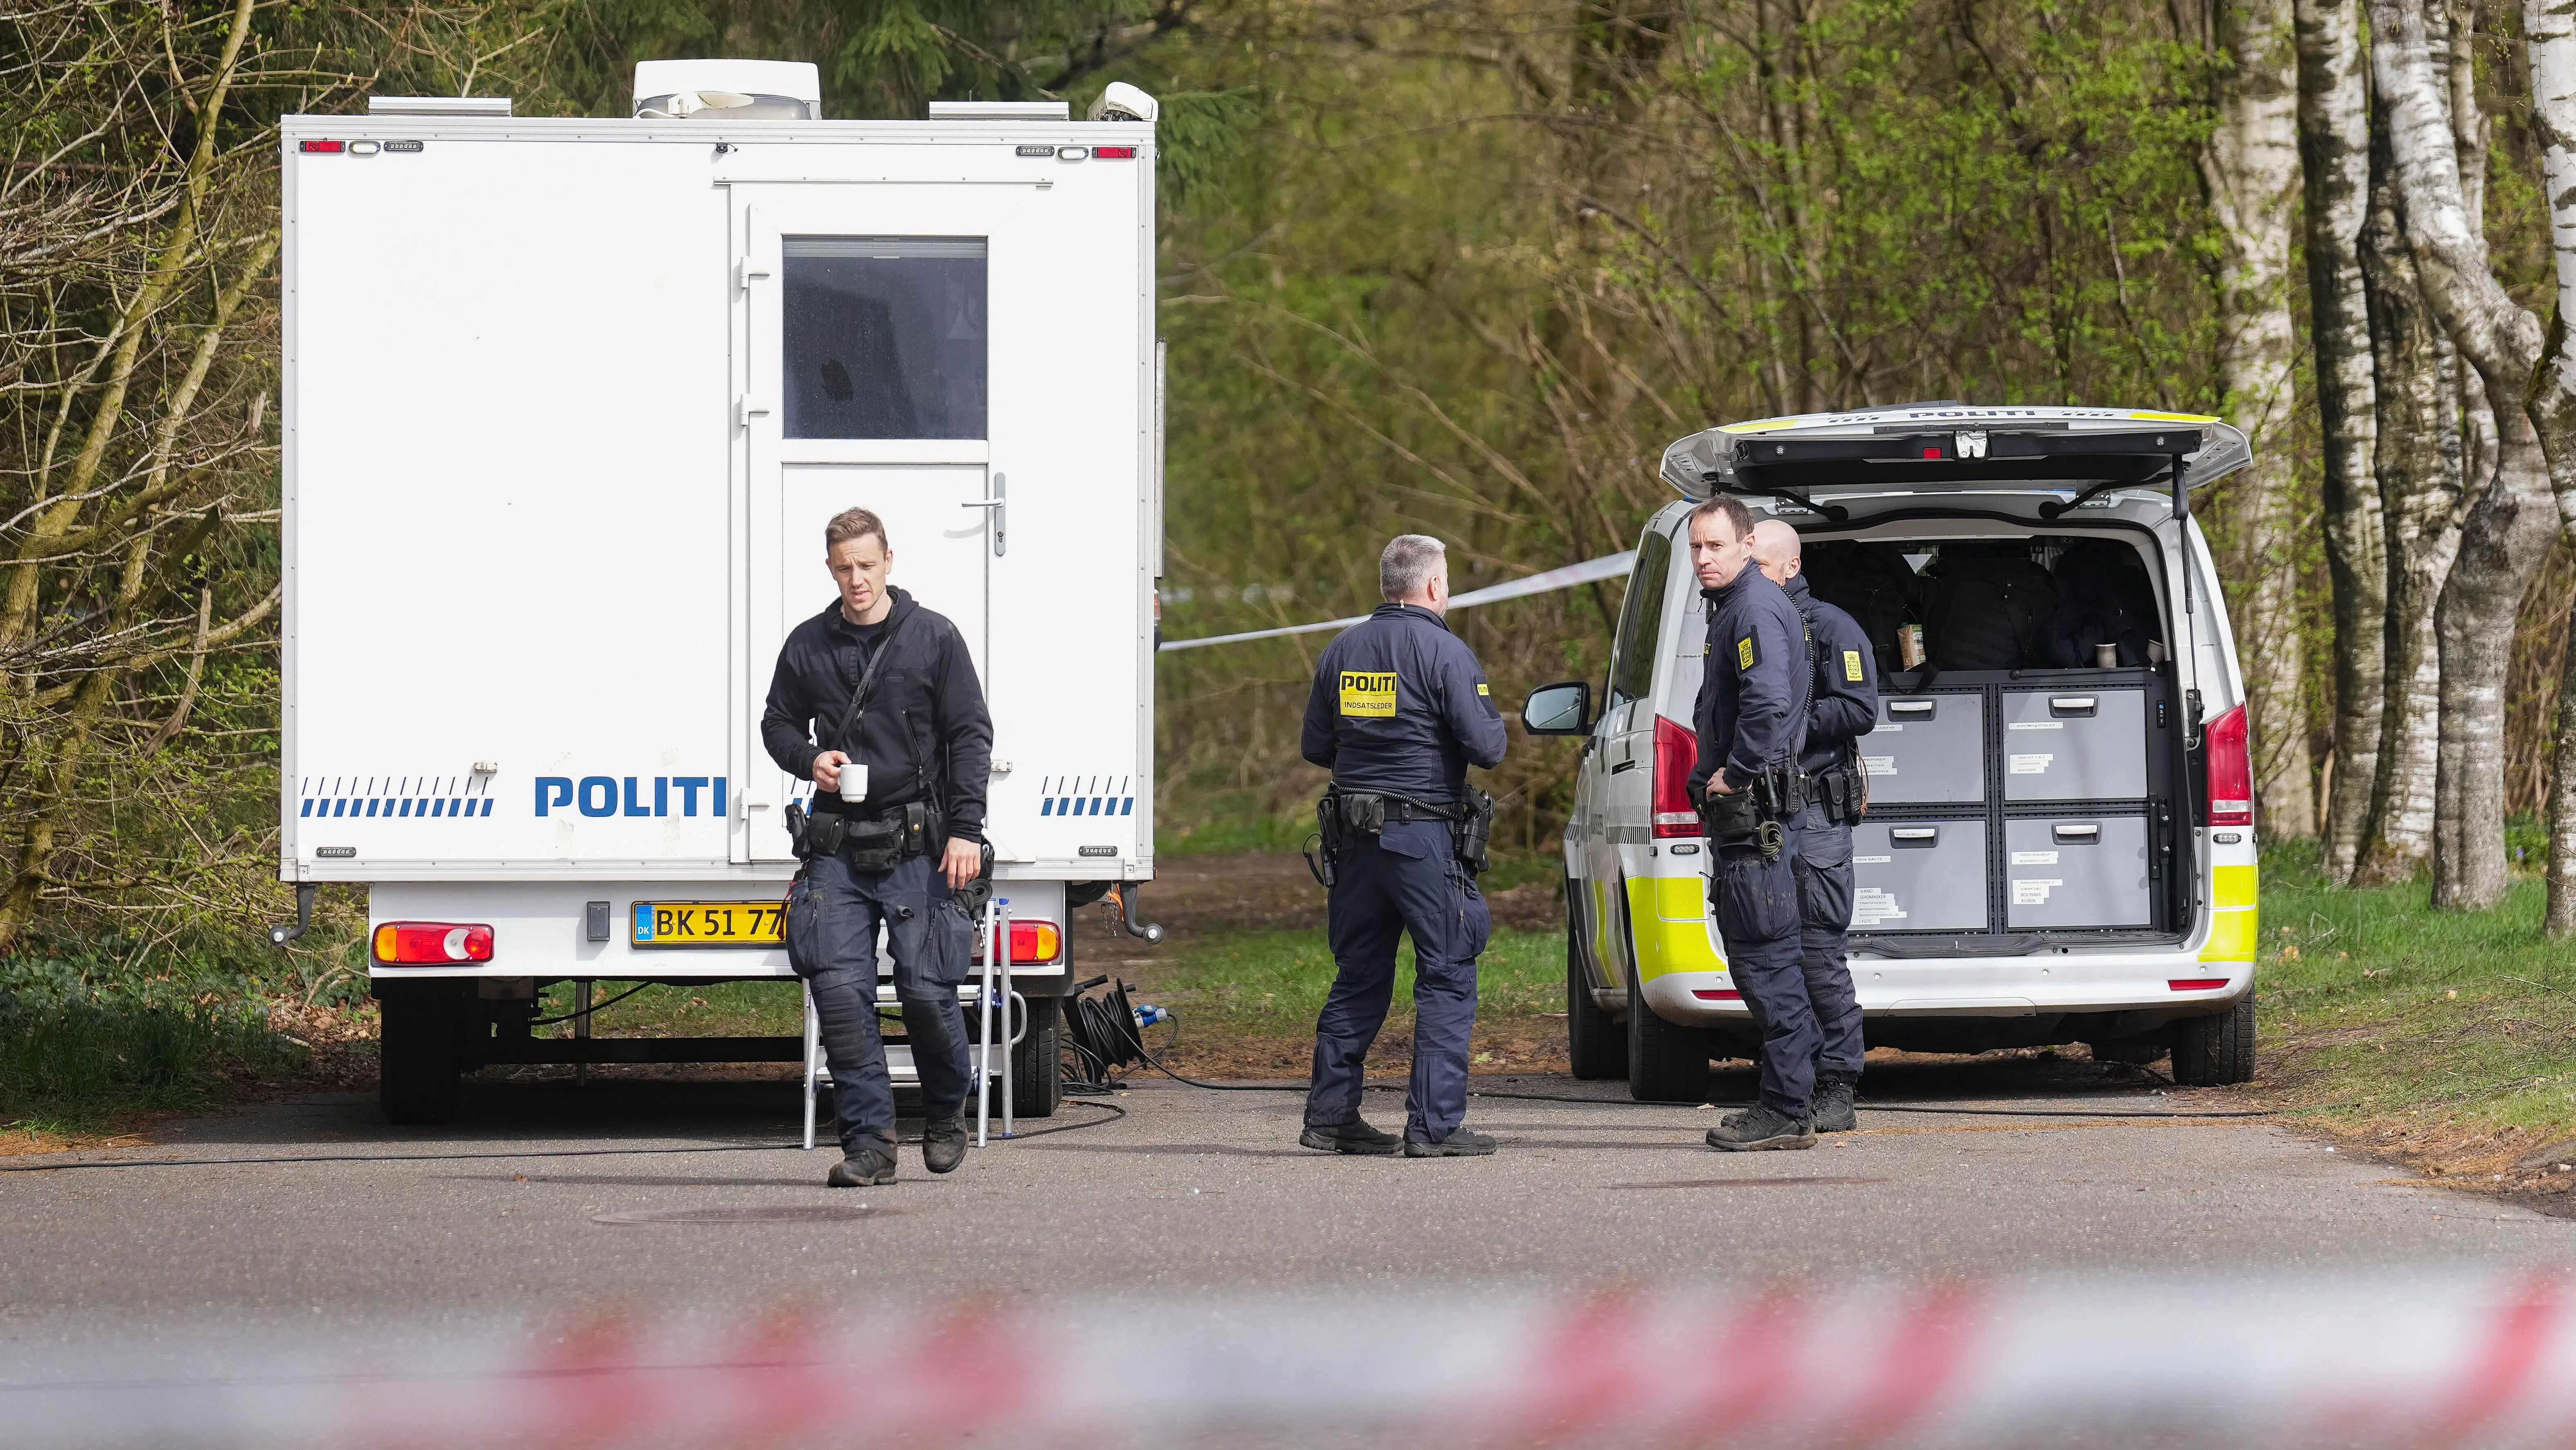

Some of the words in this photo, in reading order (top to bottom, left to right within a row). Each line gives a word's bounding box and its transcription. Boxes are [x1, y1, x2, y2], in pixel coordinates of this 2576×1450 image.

[1342, 675, 1396, 691] POLITI
[535, 776, 726, 817] POLITI
[638, 926, 650, 934] DK
[657, 910, 694, 935] BK
[704, 910, 735, 935] 51
[748, 910, 782, 935] 77
